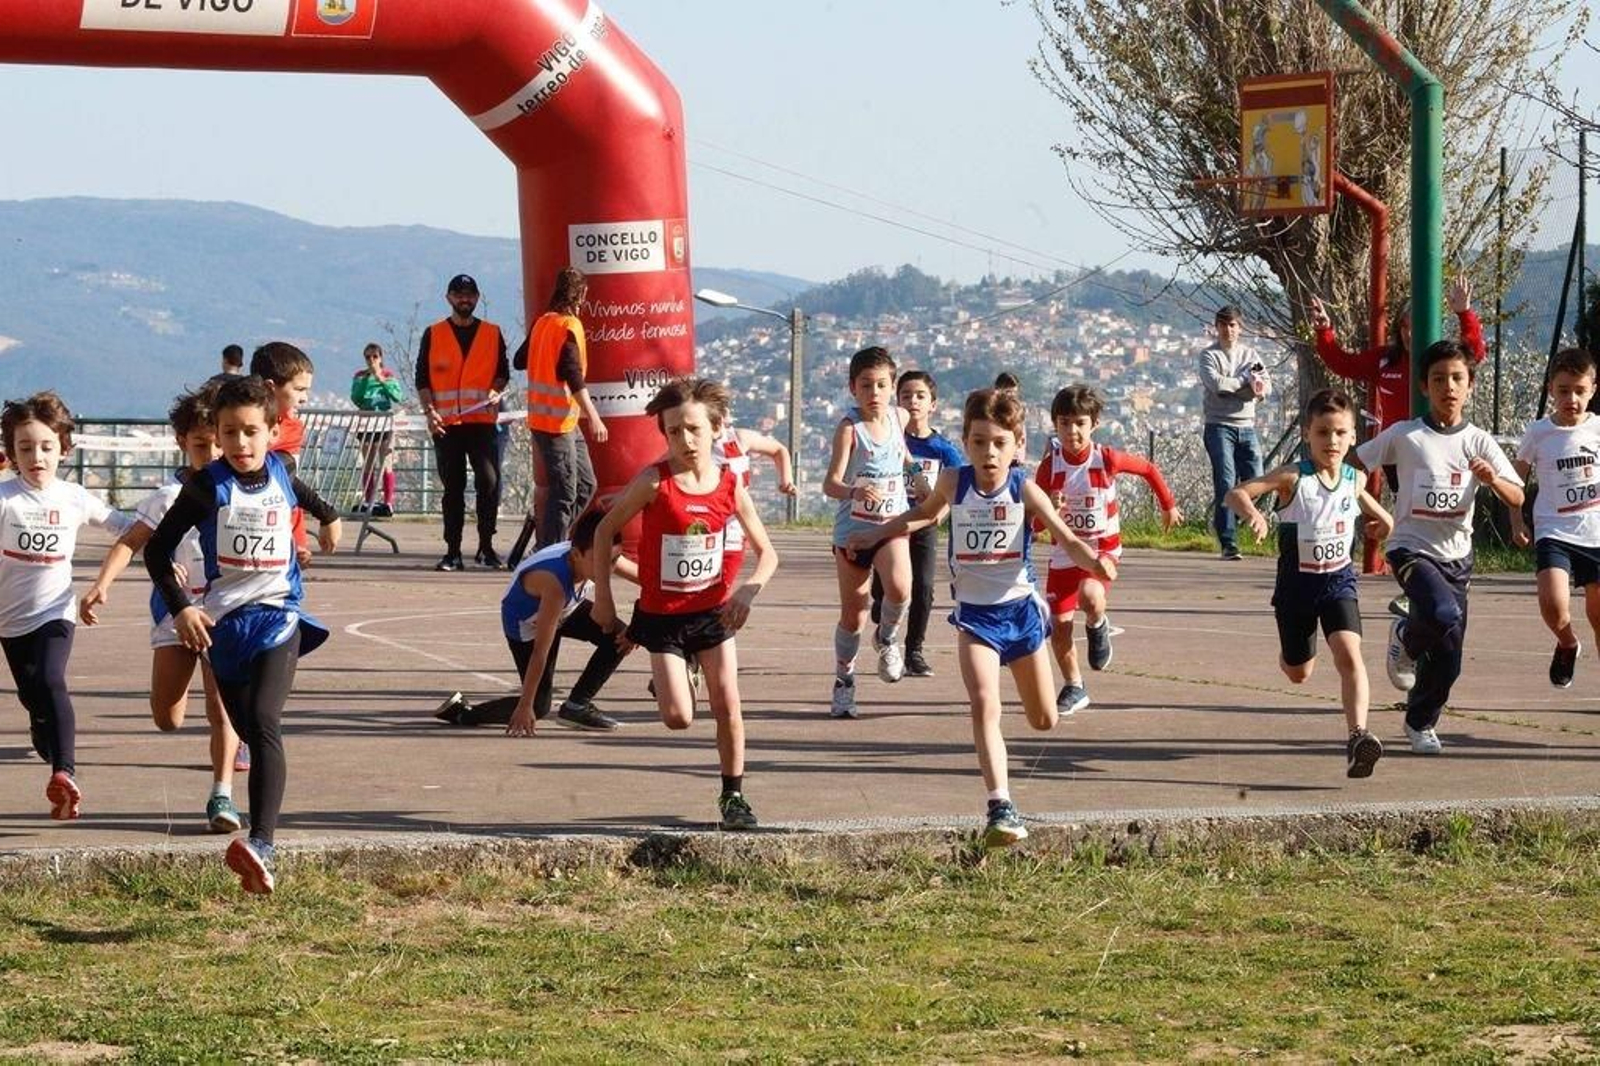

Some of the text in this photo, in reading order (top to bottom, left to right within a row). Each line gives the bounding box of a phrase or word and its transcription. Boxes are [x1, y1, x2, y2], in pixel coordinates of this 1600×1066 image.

[516, 49, 588, 115] terreo de
[575, 231, 658, 248] CONCELLO
[586, 248, 650, 263] DE VIGO
[583, 301, 645, 318] Vivimos
[585, 321, 687, 341] cidade fermosa
[625, 369, 669, 390] VIGO
[1425, 491, 1459, 509] 093
[1566, 484, 1597, 503] 078
[864, 498, 893, 513] 076
[1064, 513, 1095, 528] 206
[18, 532, 59, 552] 092
[233, 534, 275, 556] 074
[966, 530, 1006, 549] 072
[1313, 541, 1344, 561] 088
[677, 557, 713, 578] 094
